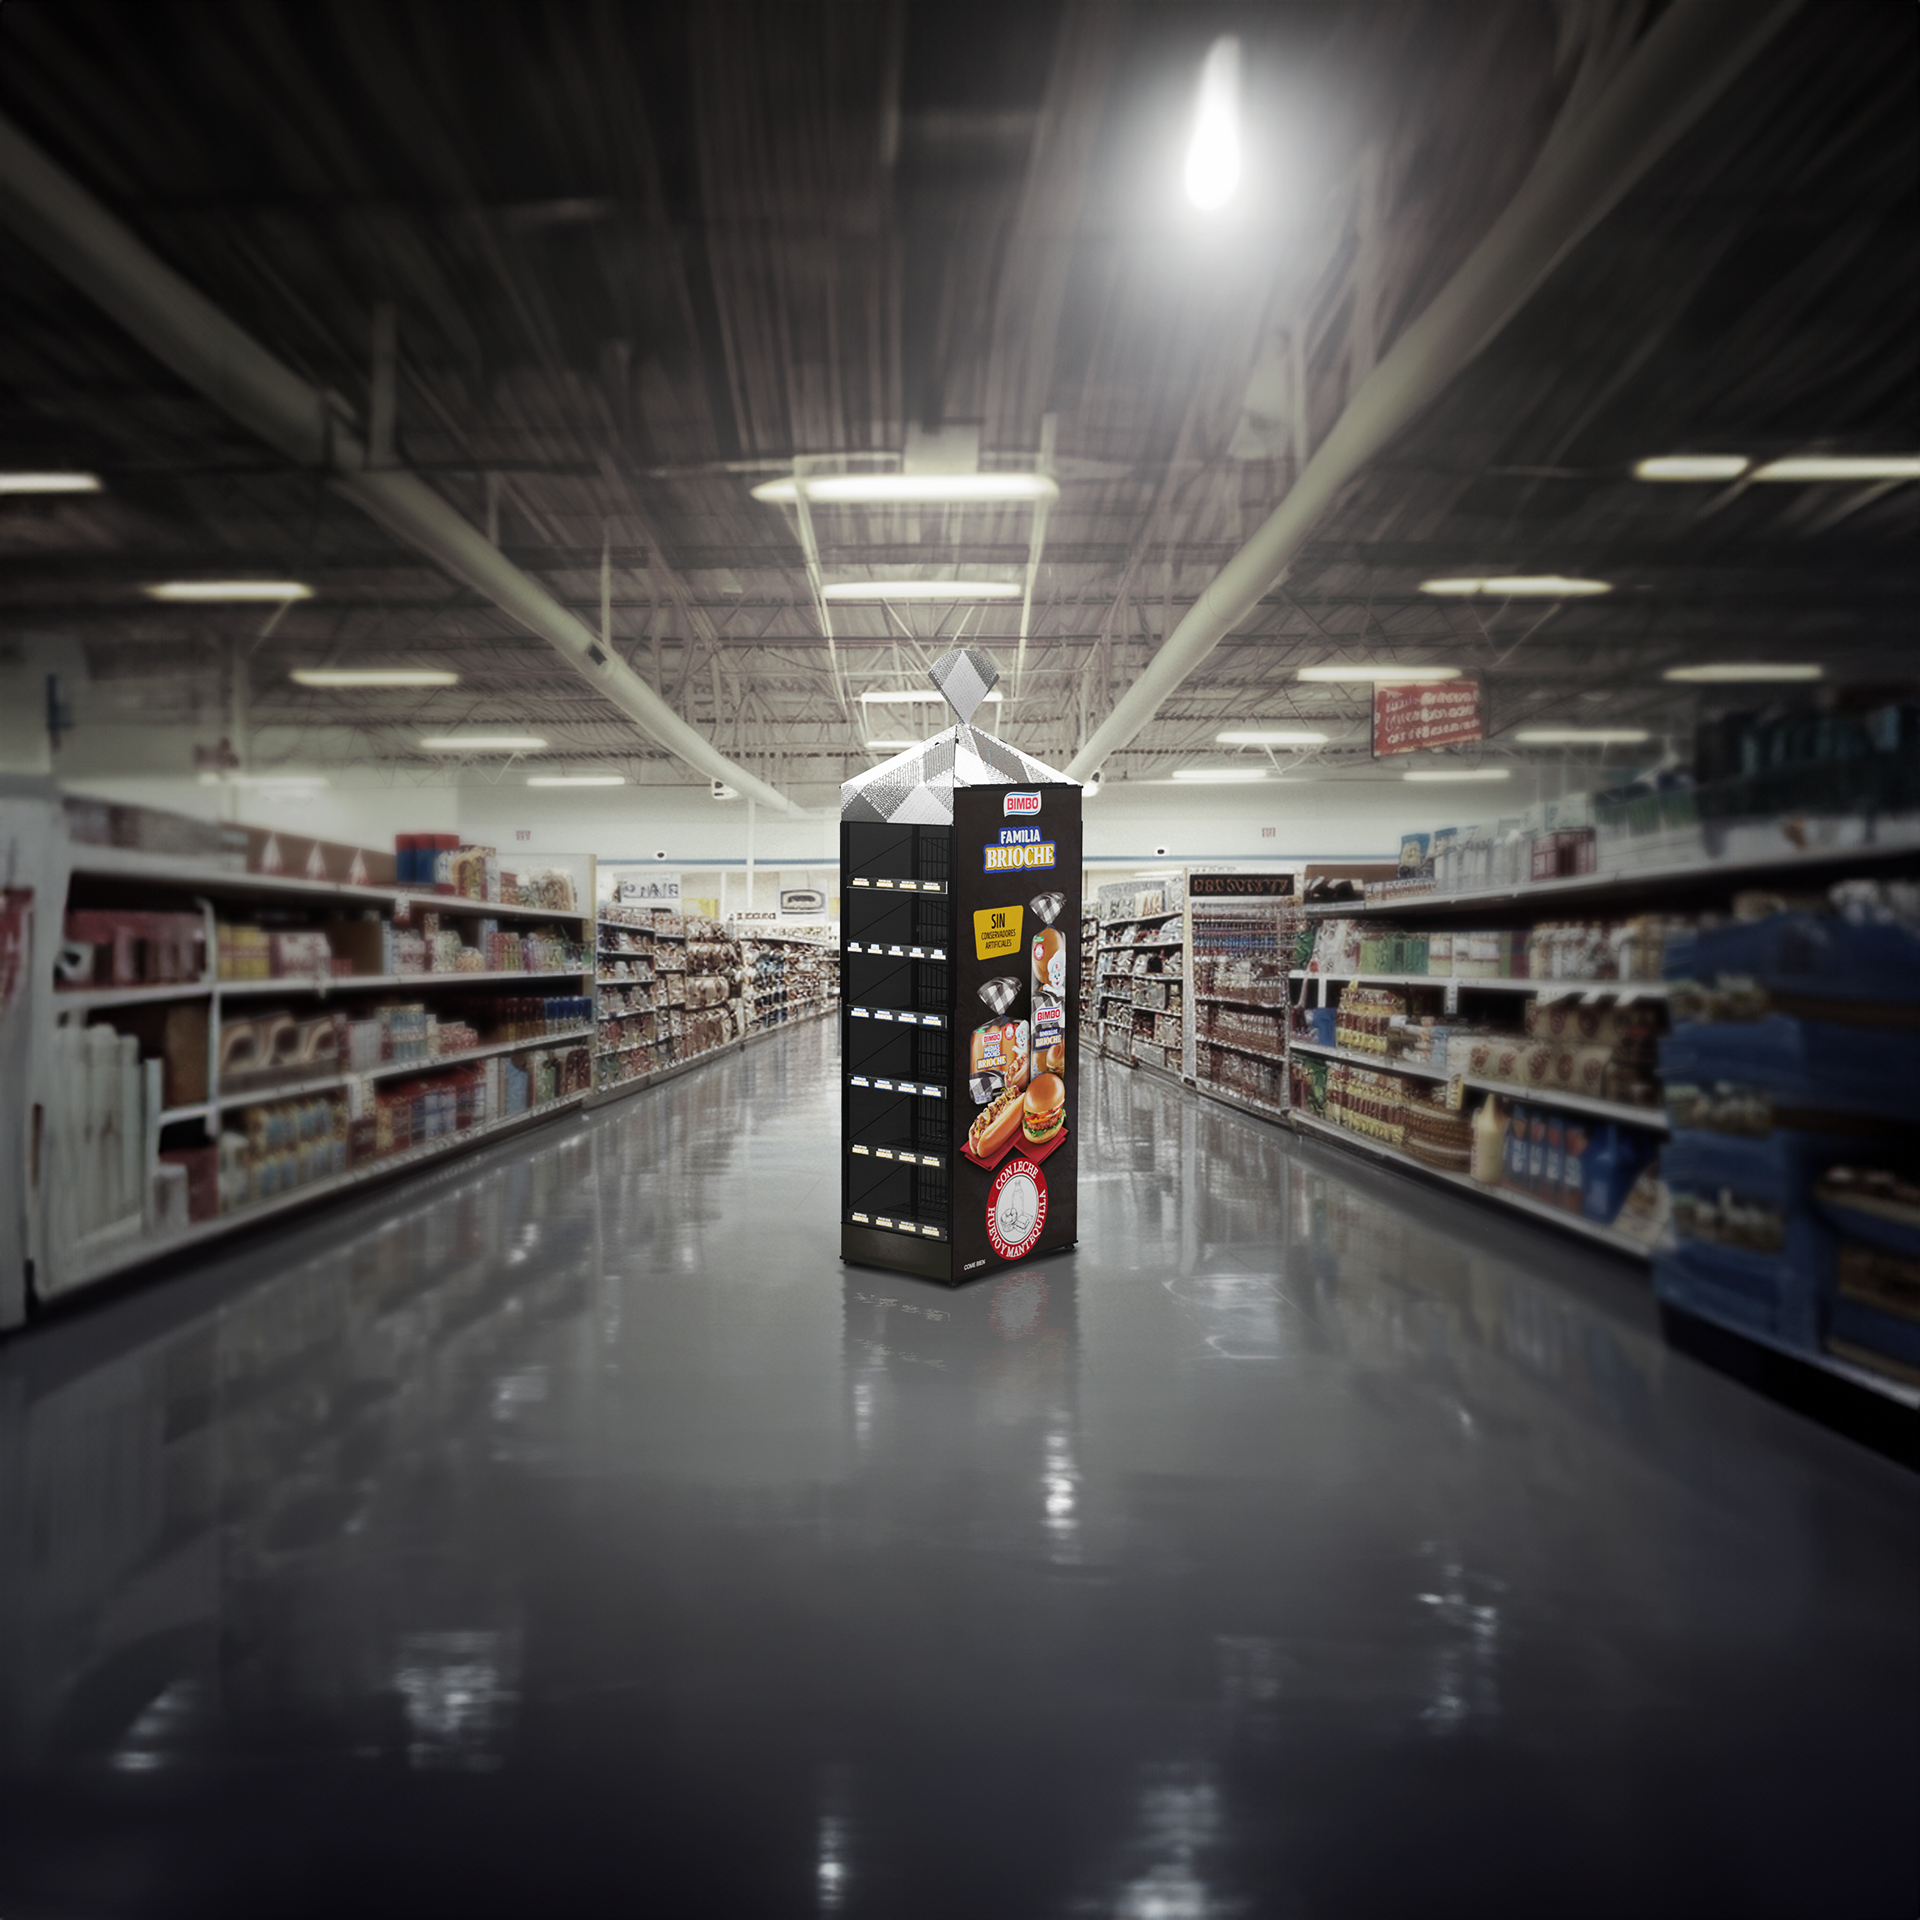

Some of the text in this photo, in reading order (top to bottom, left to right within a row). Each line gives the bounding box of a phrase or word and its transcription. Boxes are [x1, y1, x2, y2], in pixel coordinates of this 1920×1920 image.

[1007, 797, 1039, 810] BIMBO
[1000, 829, 1040, 844] FAMILIA
[986, 845, 1054, 868] BRIOCHE
[991, 913, 1005, 929] SIN
[981, 929, 1016, 940] CONSERVADORES
[985, 939, 1012, 949] ARTIFICIALES
[1037, 1009, 1061, 1021] BIMBO
[1035, 1034, 1062, 1048] BRIOCHE
[977, 1055, 1007, 1069] BRIOCHE
[995, 1161, 1039, 1190] CON LECHE
[988, 1208, 1002, 1249] HUEVO
[1006, 1189, 1046, 1257] MANTEQUILLA
